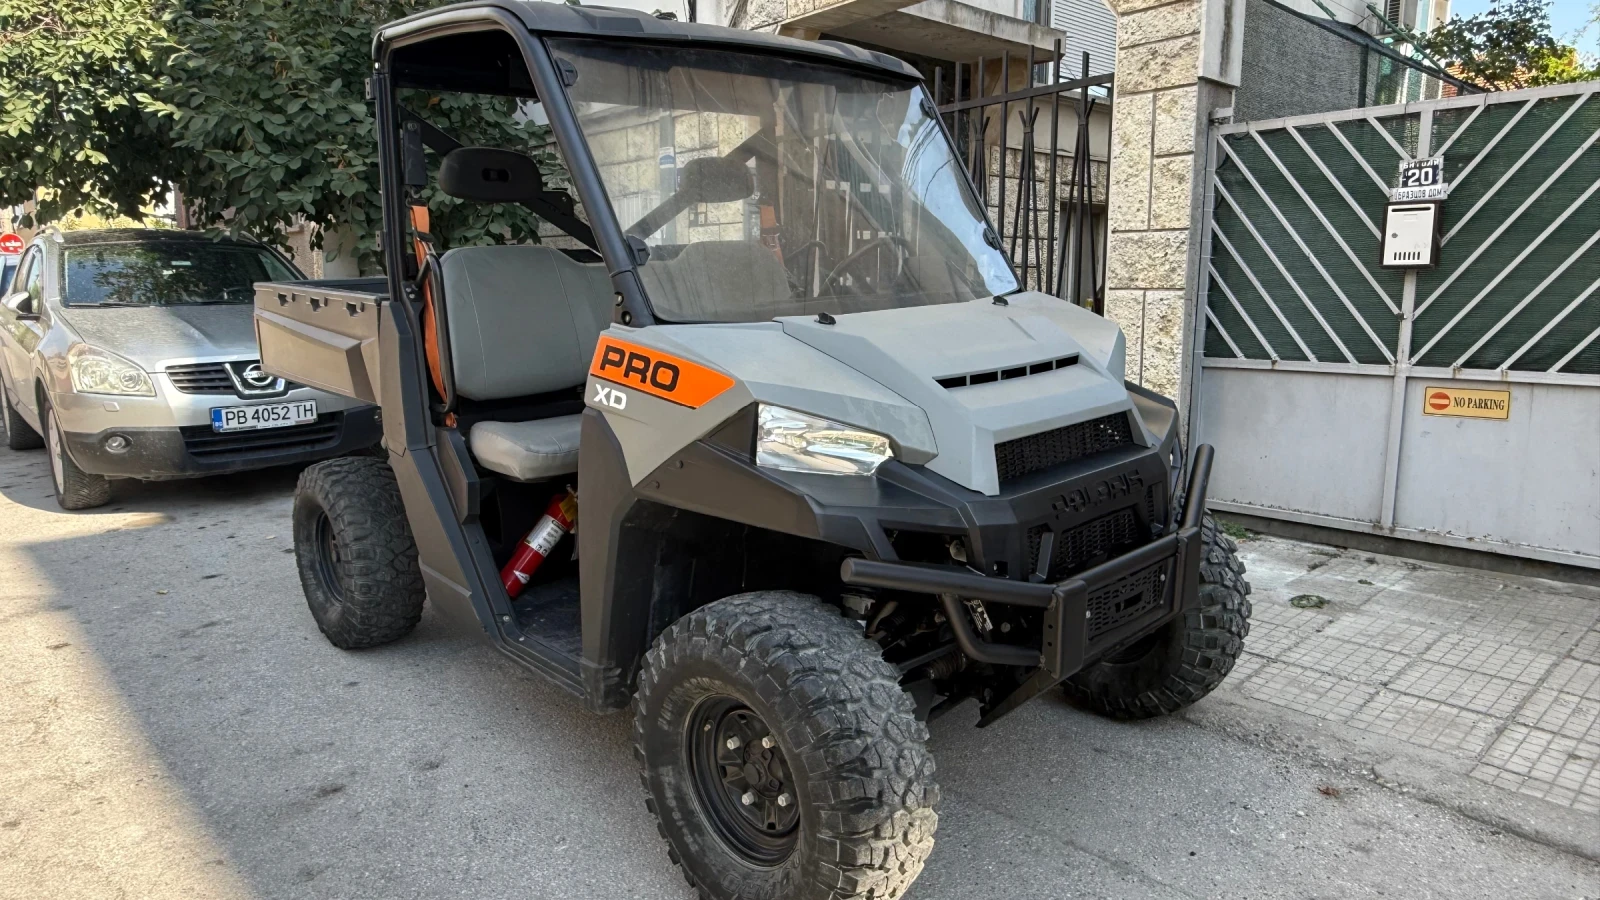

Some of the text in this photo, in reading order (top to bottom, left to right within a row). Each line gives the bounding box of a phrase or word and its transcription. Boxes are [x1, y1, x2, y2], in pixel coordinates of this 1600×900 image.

[1407, 167, 1433, 187] 20
[1428, 188, 1442, 198] ДОМ
[600, 345, 680, 392] PRO
[593, 384, 627, 410] XD
[1453, 396, 1505, 410] NO PARKING
[225, 403, 314, 426] PB 4052 TH
[1049, 469, 1144, 520] POLARIS
